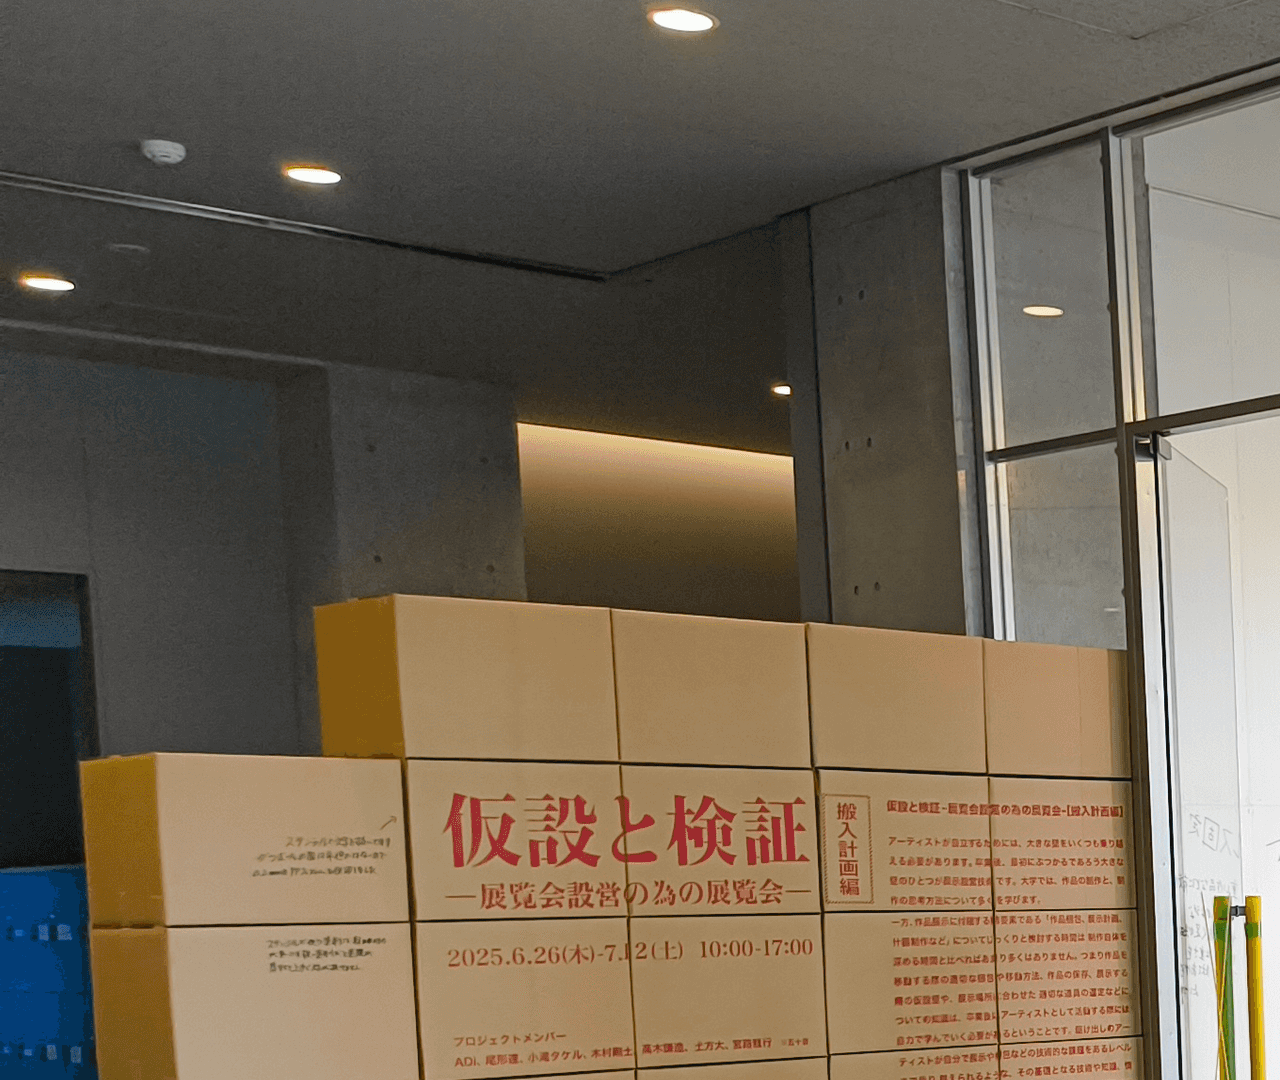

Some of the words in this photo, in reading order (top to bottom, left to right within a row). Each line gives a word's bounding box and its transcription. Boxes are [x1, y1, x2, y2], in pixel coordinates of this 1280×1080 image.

[442, 792, 811, 868] 仮設と検証
[836, 801, 861, 897] 搬入計画編
[699, 937, 814, 960] 10:00-17:00
[453, 1031, 568, 1048] プロジェクトメンバー
